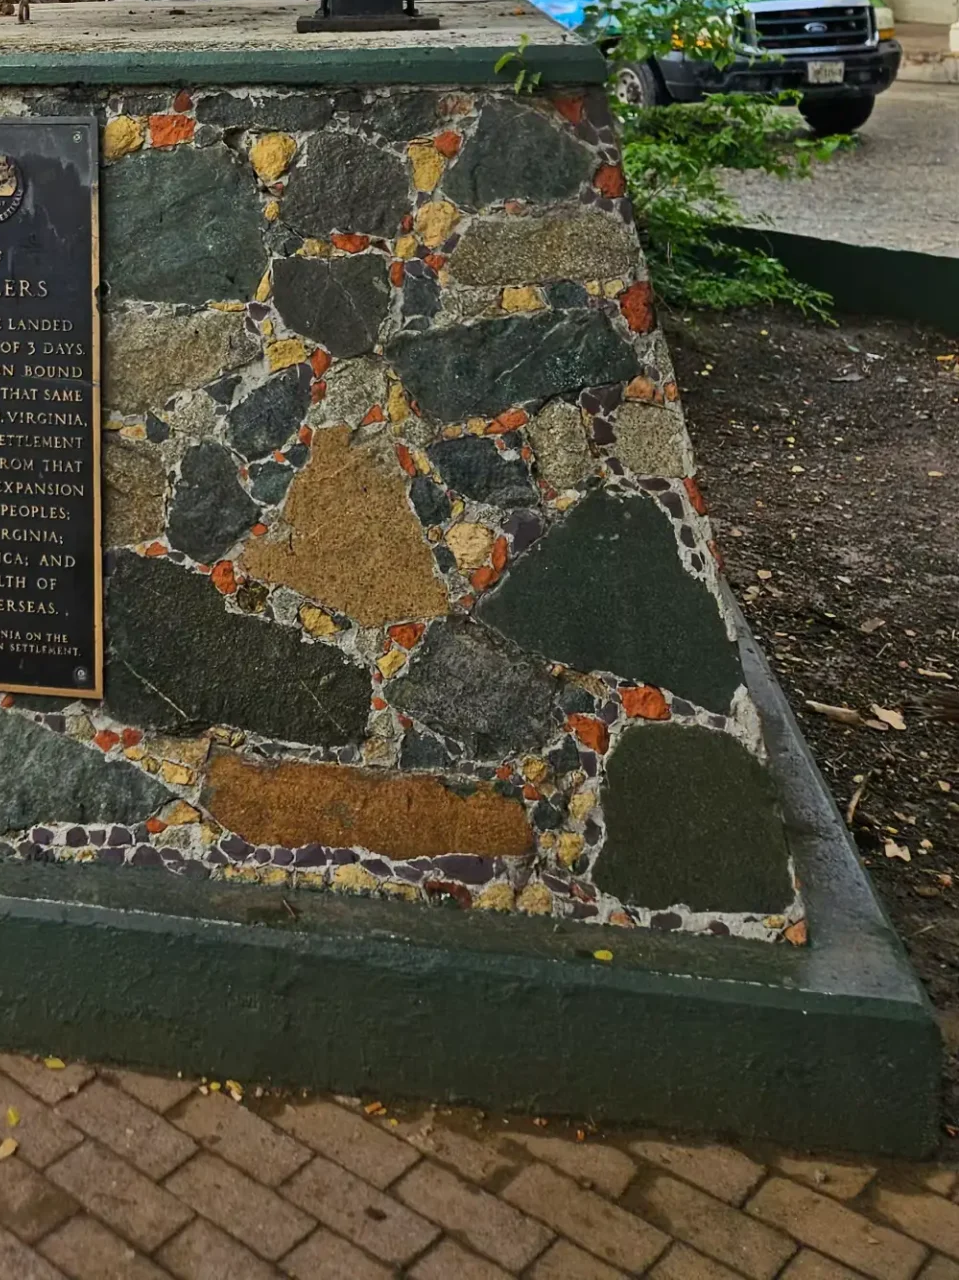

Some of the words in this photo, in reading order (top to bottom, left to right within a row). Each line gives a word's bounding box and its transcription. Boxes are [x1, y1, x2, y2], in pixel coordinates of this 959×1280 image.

[8, 318, 73, 332] LANDED
[0, 342, 19, 354] OF
[27, 342, 36, 355] 3
[43, 343, 86, 355] DAYS.
[24, 365, 83, 378] BOUND
[1, 388, 38, 400] THAT
[44, 389, 83, 402] SAME
[7, 412, 87, 427] VIRGINIA,
[43, 459, 83, 473] THAT
[1, 505, 70, 520] PEOPLES;
[40, 554, 75, 567] AND
[37, 578, 58, 590] OF
[26, 632, 41, 641] ON
[46, 633, 68, 643] THE
